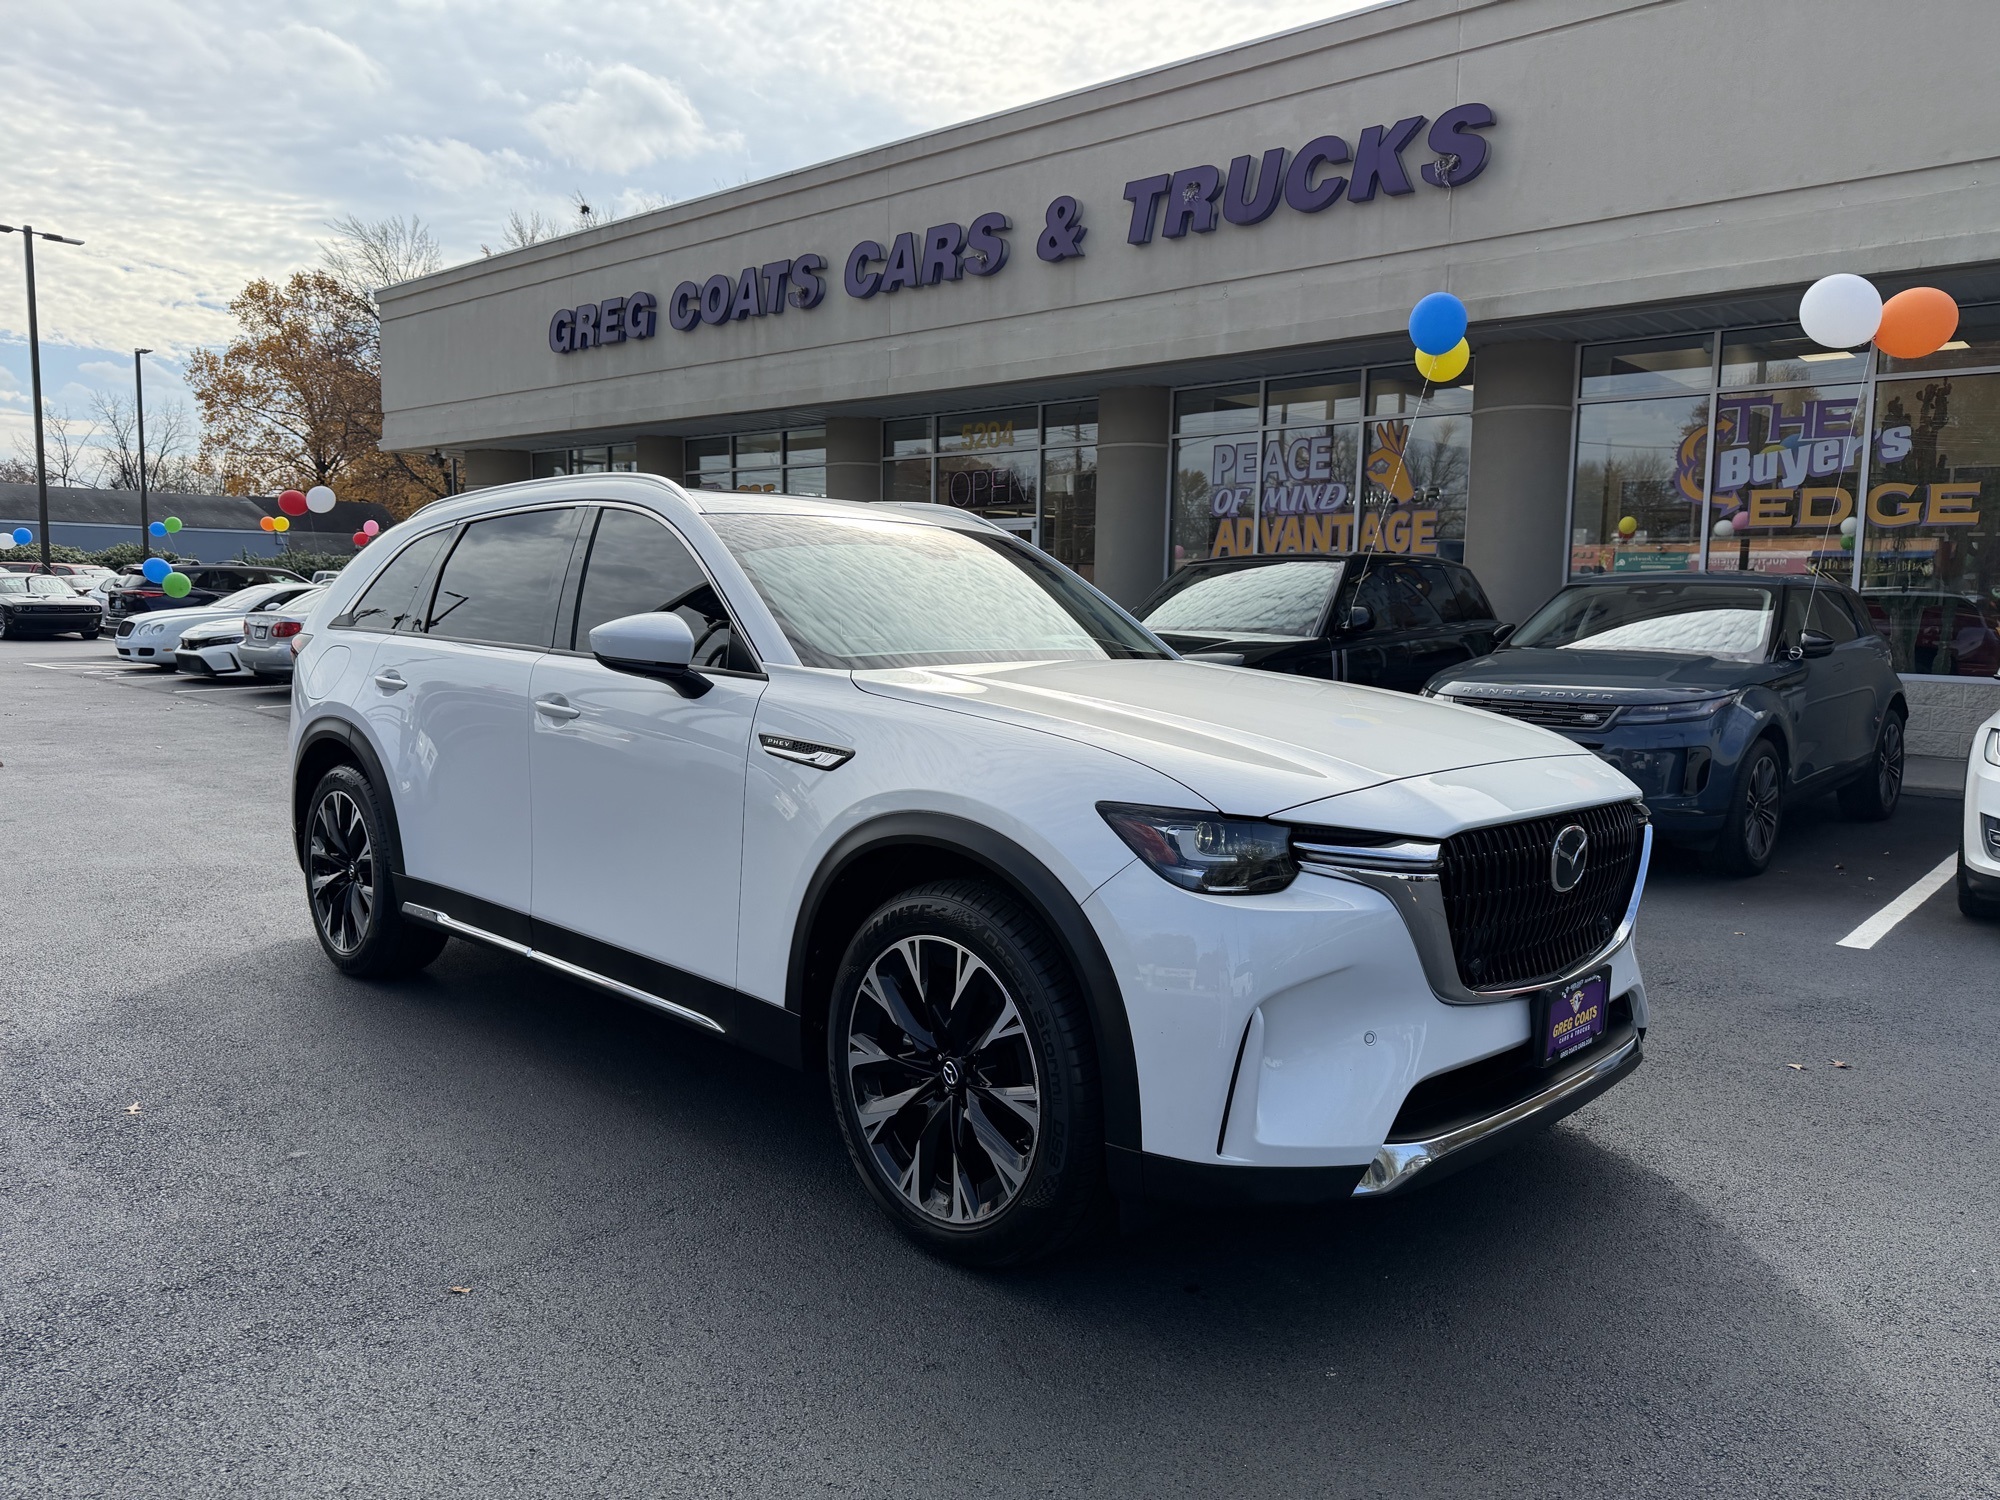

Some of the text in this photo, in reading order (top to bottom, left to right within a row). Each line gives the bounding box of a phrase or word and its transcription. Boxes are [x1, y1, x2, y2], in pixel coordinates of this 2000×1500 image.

[549, 102, 1497, 354] GREG COATS CARS & TRUCKS
[961, 420, 1014, 450] 5204
[1717, 395, 1859, 446] THE
[1213, 436, 1332, 485] PEACE
[1716, 425, 1912, 490] Buyer's
[950, 466, 1028, 507] OPEN
[1212, 487, 1252, 517] OF
[1262, 482, 1348, 516] MIND
[1748, 480, 1982, 528] EDGE
[1210, 509, 1438, 558] ADVANTAGE
[1462, 686, 1613, 700] RANGE ROVER
[767, 738, 790, 746] PHEV
[1553, 1006, 1598, 1037] GREG COATS
